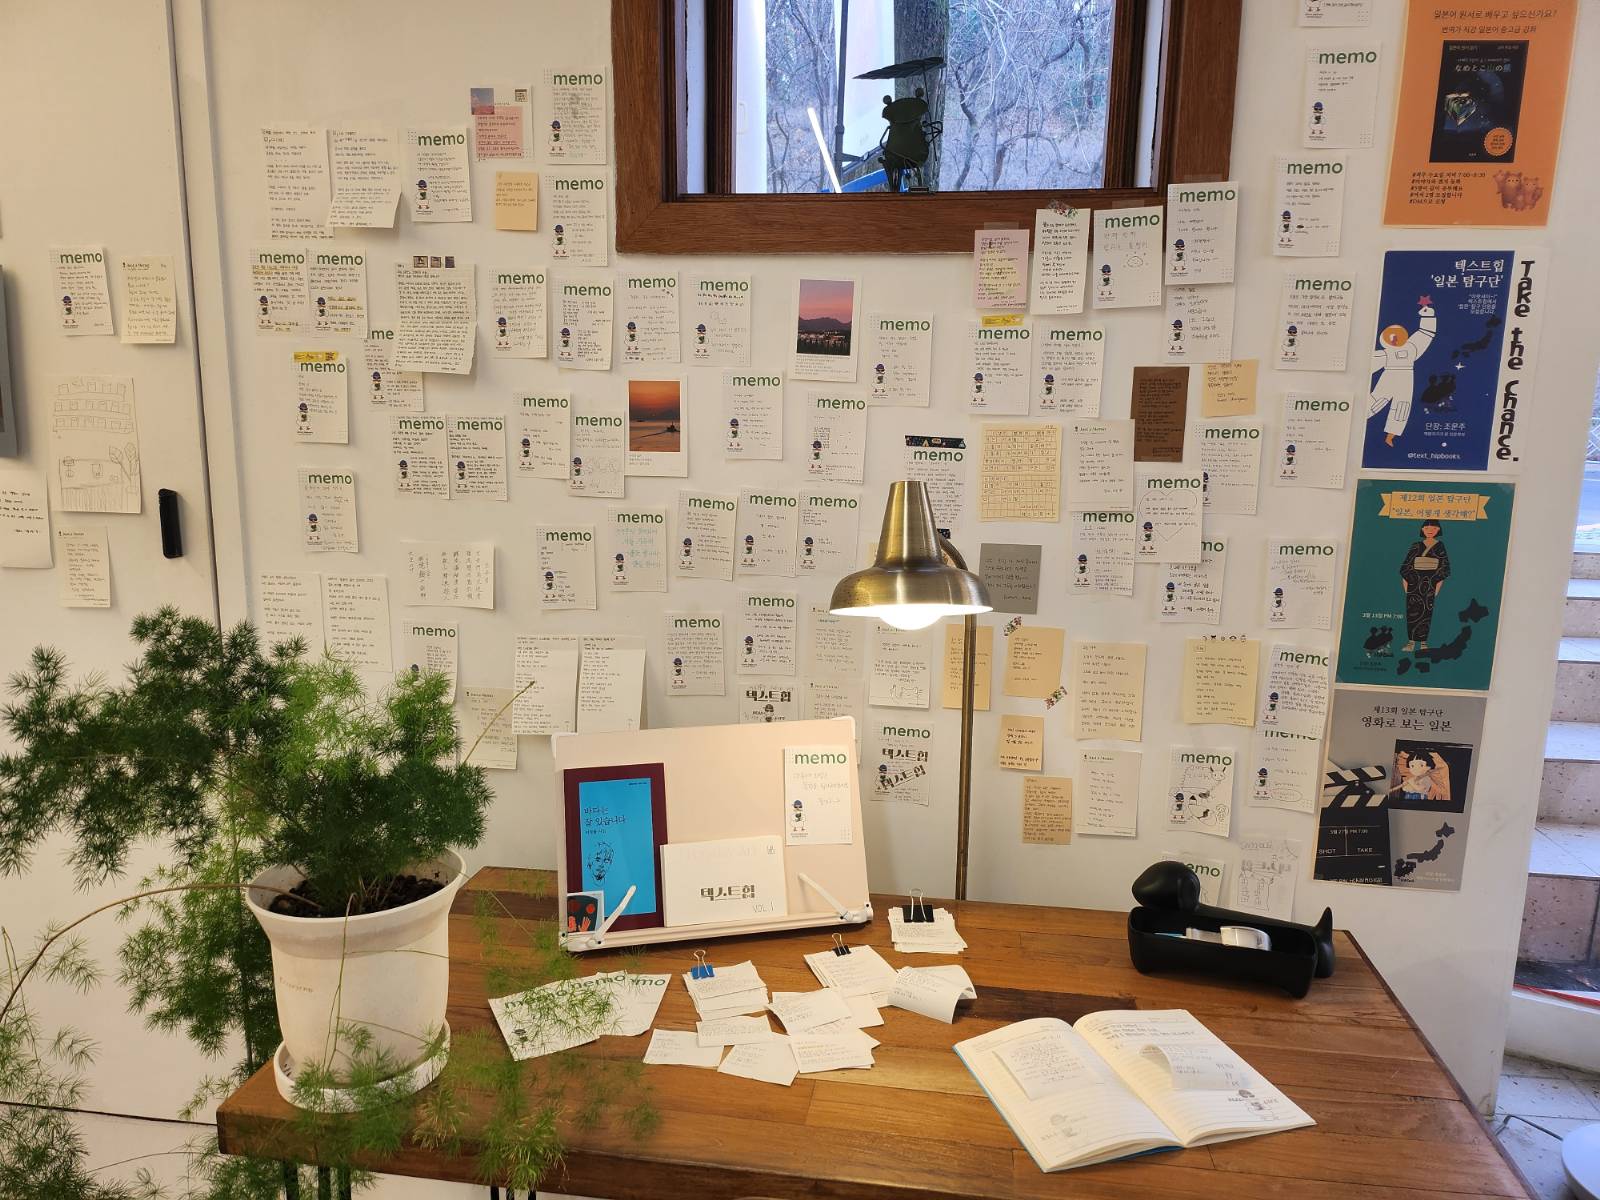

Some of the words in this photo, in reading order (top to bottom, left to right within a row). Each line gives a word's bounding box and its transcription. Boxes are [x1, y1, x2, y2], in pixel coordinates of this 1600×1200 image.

[1319, 51, 1377, 64] memo
[554, 74, 603, 85] memo
[418, 132, 464, 147] memo
[1287, 163, 1343, 175] memo
[556, 180, 603, 190] memo
[1180, 190, 1235, 203] memo
[1105, 213, 1160, 229] memo
[60, 251, 102, 265] memo
[260, 254, 304, 264] memo
[317, 255, 363, 265] memo
[1455, 259, 1505, 273] 텍스트힙
[498, 274, 544, 284] memo
[628, 278, 676, 288] memo
[564, 284, 612, 297] memo
[700, 281, 748, 292] memo
[1295, 280, 1351, 291] memo
[1514, 260, 1536, 318] Take
[880, 320, 930, 331] memo
[978, 329, 1030, 339] memo
[1050, 329, 1102, 341] memo
[1507, 327, 1525, 370] the
[300, 360, 346, 374] memo
[733, 377, 780, 387] memo
[523, 398, 568, 408] memo
[817, 398, 865, 410] memo
[1295, 400, 1349, 412] memo
[399, 418, 444, 431] memo
[457, 418, 503, 431] memo
[575, 414, 622, 427] memo
[1205, 429, 1259, 439] memo
[914, 449, 963, 462] memo
[309, 473, 353, 486] memo
[1148, 478, 1201, 489] memo
[689, 498, 735, 512] memo
[750, 494, 798, 507] memo
[810, 496, 857, 508] memo
[618, 514, 663, 523] memo
[1082, 511, 1134, 523] memo
[546, 532, 592, 541] memo
[1280, 545, 1334, 556] memo
[748, 597, 794, 608] memo
[675, 619, 720, 628] memo
[413, 627, 456, 637] memo
[746, 689, 791, 703] 텍스트힙
[1374, 705, 1398, 714] 제13회
[1400, 706, 1417, 715] 일본
[1361, 715, 1397, 728] 영화로
[1400, 718, 1425, 730] 보는
[1429, 720, 1452, 732] 일본
[883, 726, 930, 739] memo
[795, 754, 846, 764] memo
[882, 748, 928, 763] 텍스트힙
[1181, 754, 1232, 766] memo
[595, 815, 626, 826] 있습니다
[1186, 863, 1221, 877] emo
[700, 884, 755, 902] 텍스트힙
